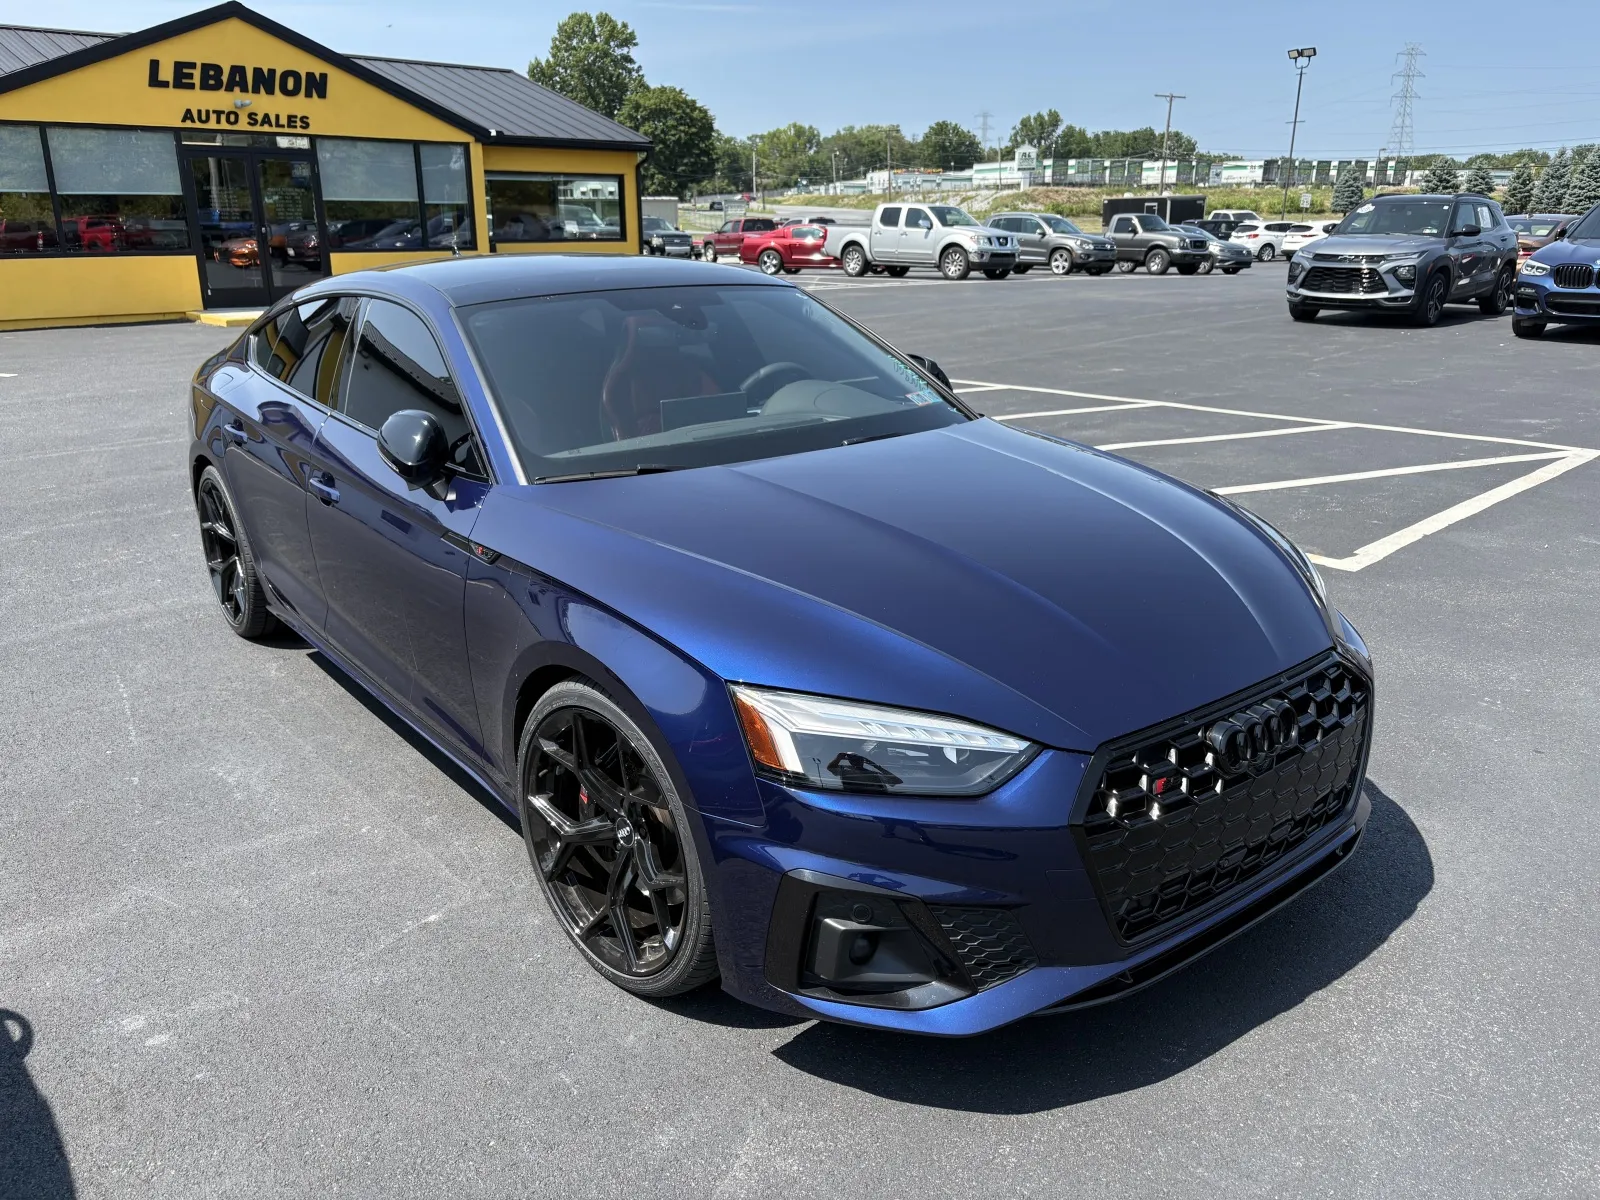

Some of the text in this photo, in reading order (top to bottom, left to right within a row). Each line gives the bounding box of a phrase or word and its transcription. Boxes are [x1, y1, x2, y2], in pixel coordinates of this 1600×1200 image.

[148, 59, 328, 99] LEBANON
[181, 108, 310, 129] AUTO SALES
